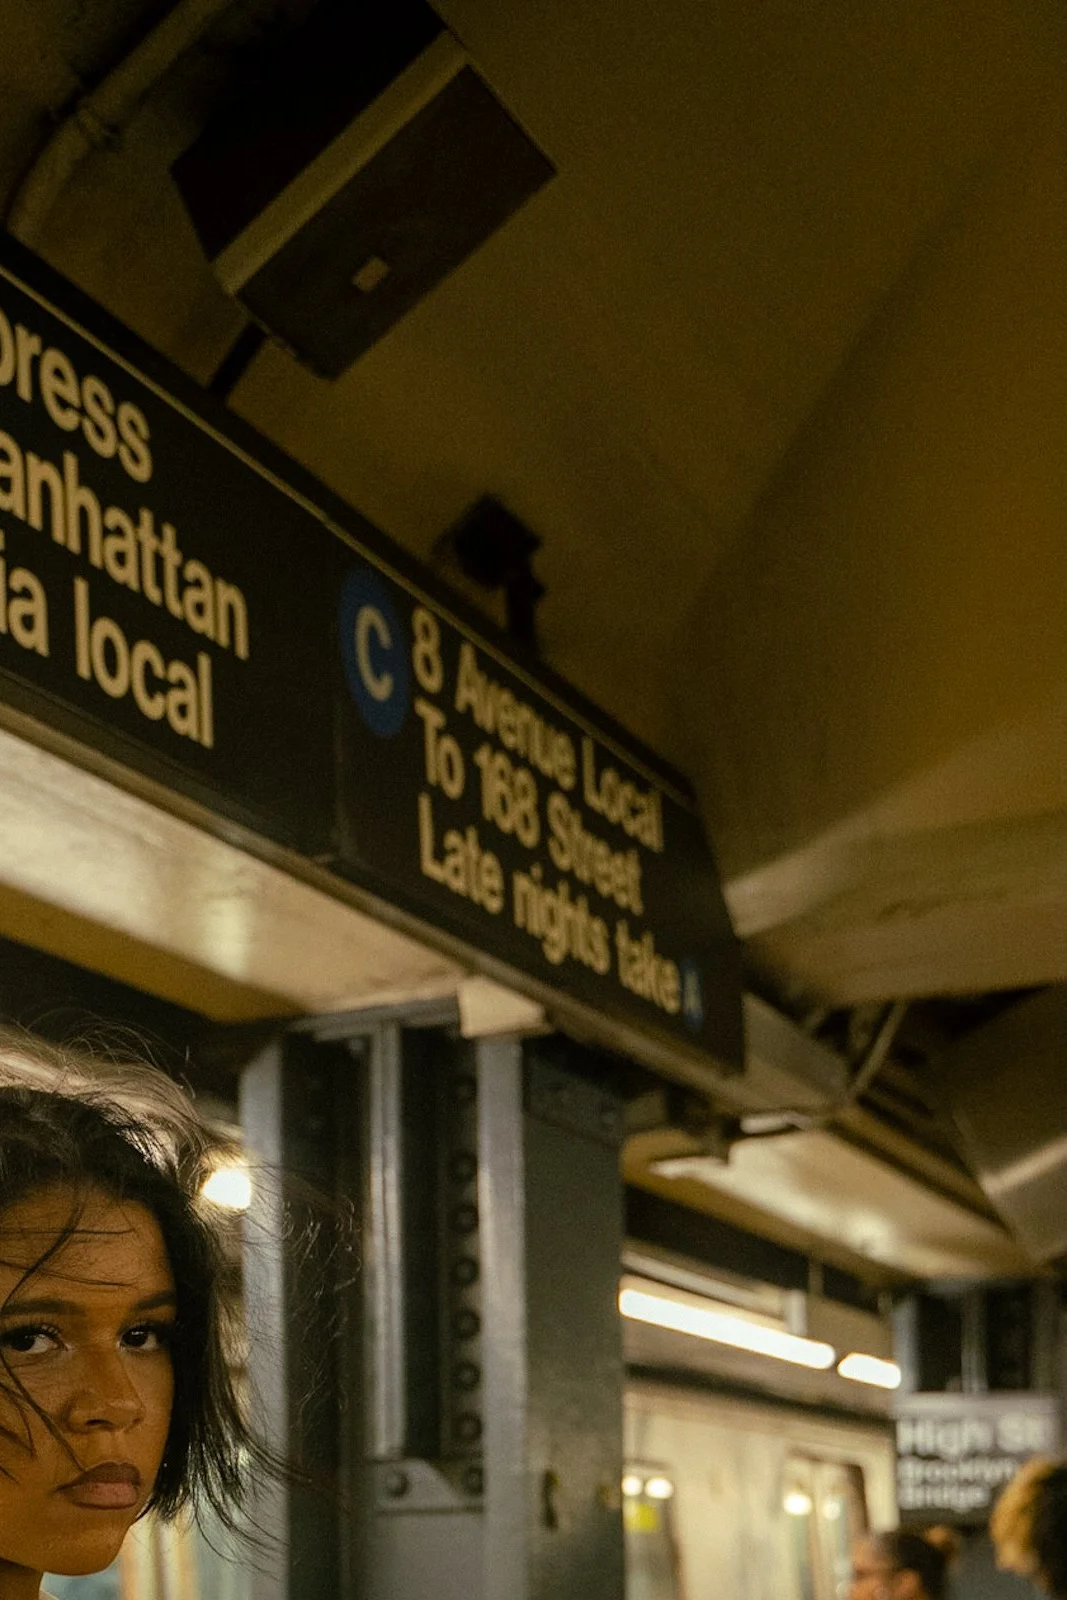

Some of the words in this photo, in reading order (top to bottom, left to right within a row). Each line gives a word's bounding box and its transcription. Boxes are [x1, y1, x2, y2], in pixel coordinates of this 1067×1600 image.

[74, 577, 215, 748] local
[354, 605, 394, 701] C
[411, 604, 445, 694] 8
[456, 641, 576, 791] Avenue
[582, 735, 665, 853] Local
[414, 699, 464, 800] To
[474, 741, 540, 849] 168
[548, 791, 644, 916] Street
[418, 792, 504, 915] Late
[512, 863, 610, 976] nights
[616, 919, 682, 1016] take
